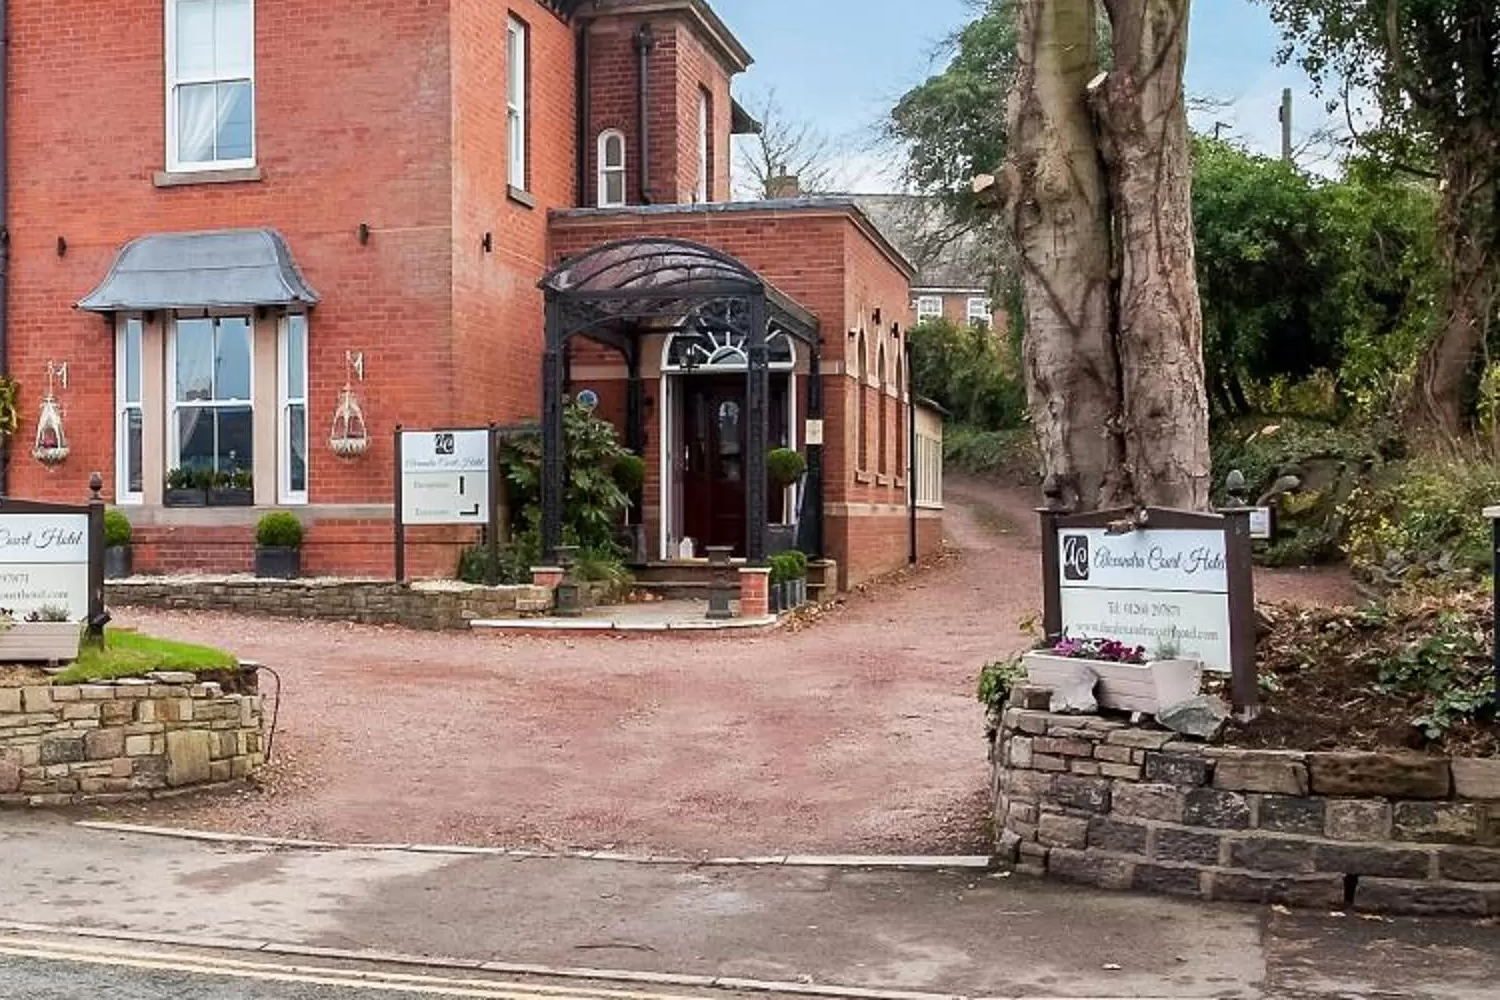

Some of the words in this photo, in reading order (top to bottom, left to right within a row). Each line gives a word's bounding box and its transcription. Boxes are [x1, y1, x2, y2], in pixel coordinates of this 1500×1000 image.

[33, 527, 84, 549] Hotel
[1093, 545, 1145, 570] Alexandra
[1149, 544, 1183, 571] Court
